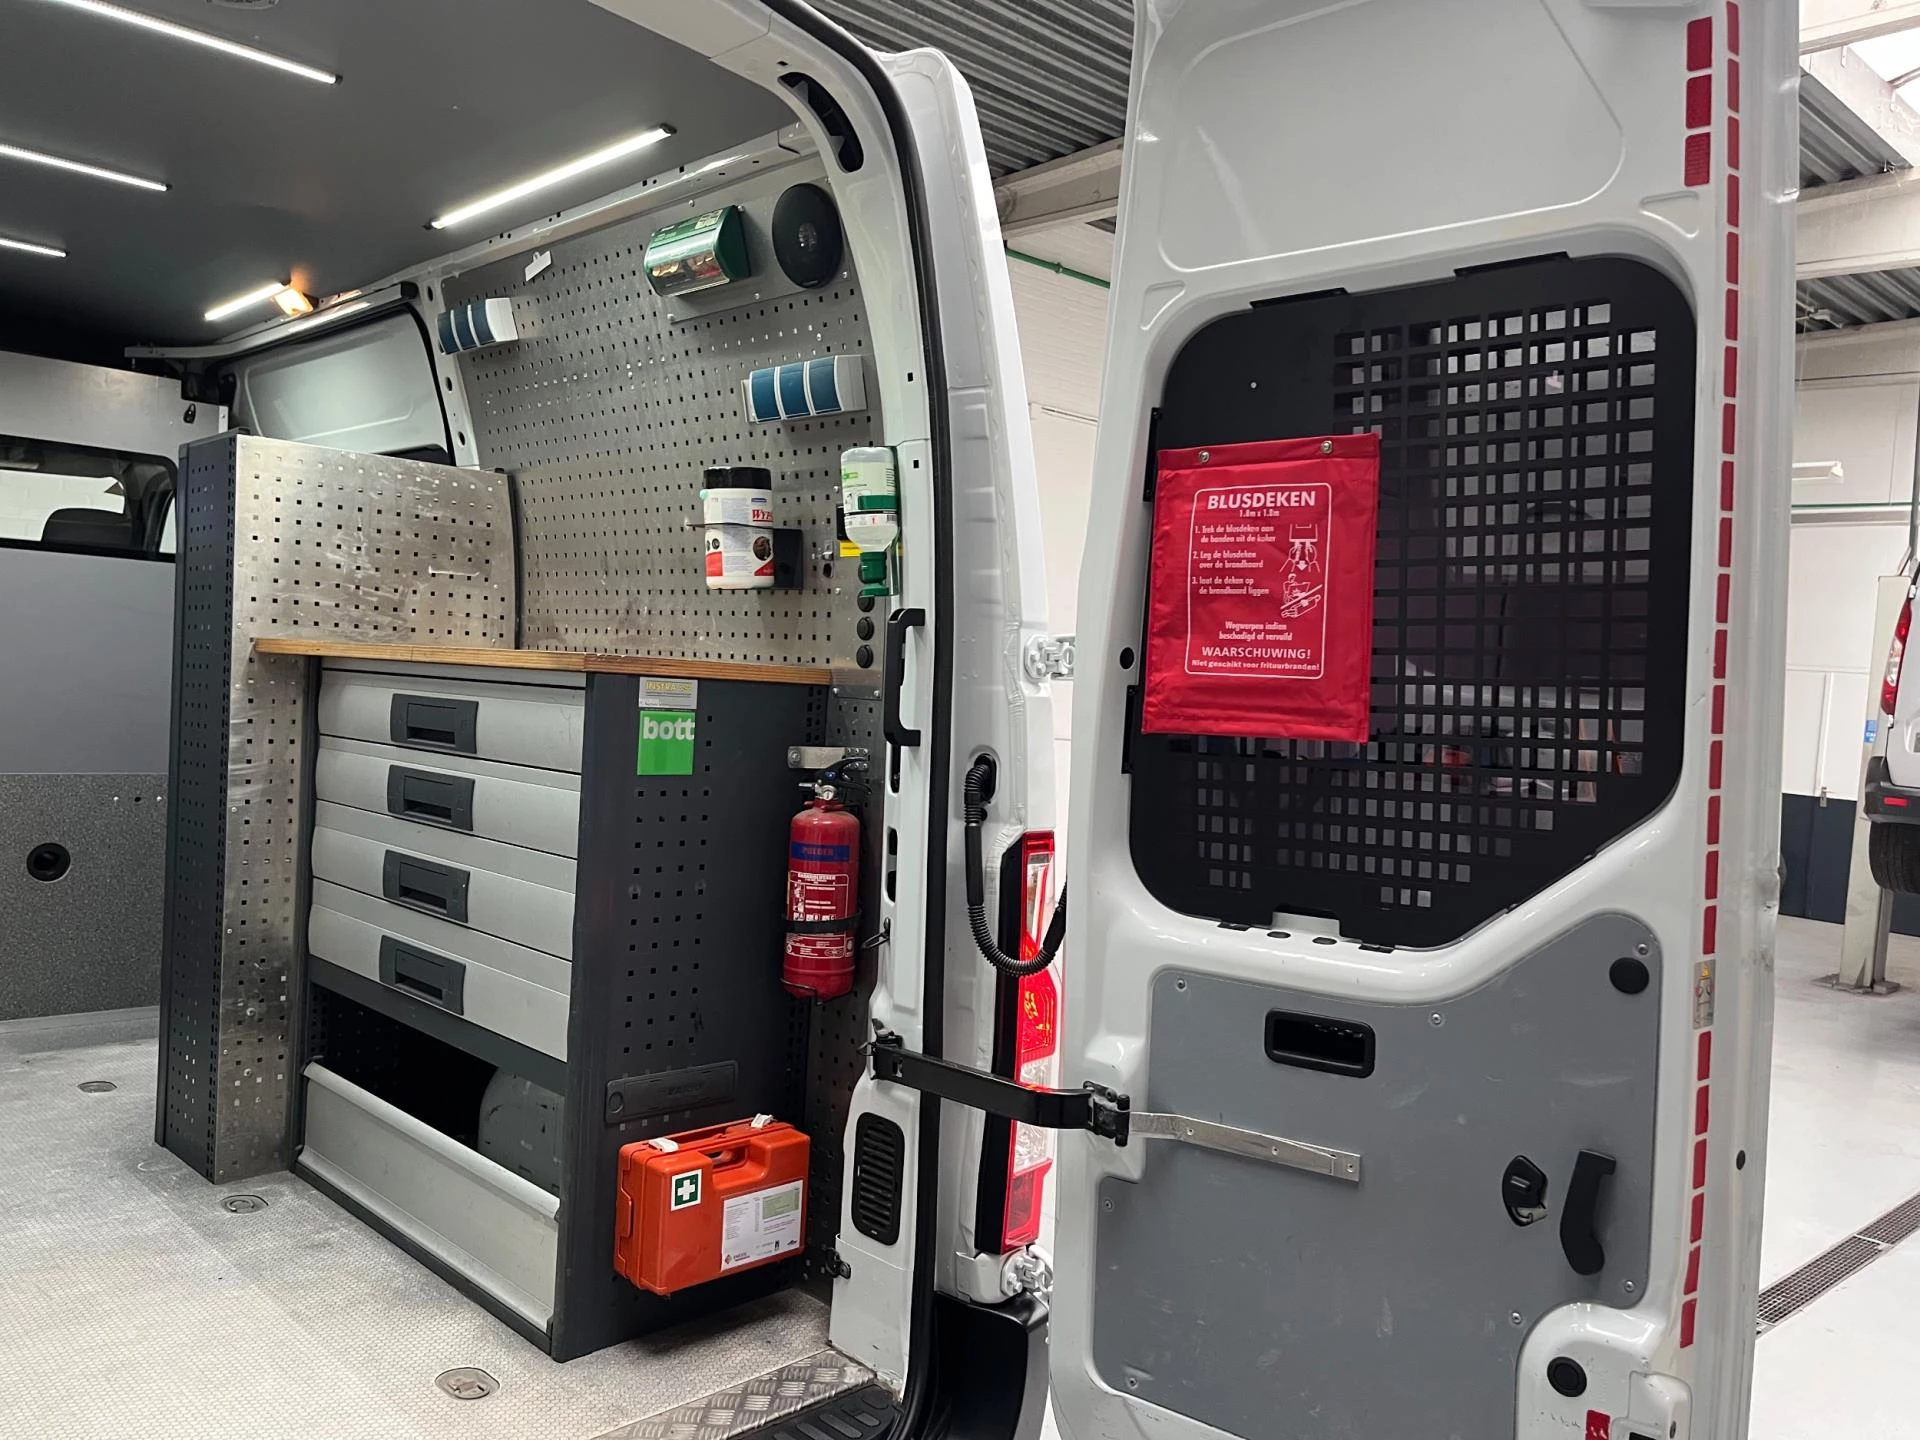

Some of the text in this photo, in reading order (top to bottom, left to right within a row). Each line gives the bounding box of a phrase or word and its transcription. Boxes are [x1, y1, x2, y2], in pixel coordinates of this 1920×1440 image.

[1207, 491, 1316, 510] BLUSDEKEN
[1194, 526, 1200, 534] 1.
[1216, 525, 1224, 533] de
[1226, 524, 1259, 533] blusdeken
[1210, 535, 1235, 543] banden
[1246, 534, 1256, 542] de
[1192, 550, 1257, 560] 2. Leg de blusdeken
[1214, 560, 1223, 568] de
[1225, 560, 1264, 568] brandhaard
[1214, 576, 1223, 584] de
[1224, 576, 1244, 584] deken
[1245, 578, 1254, 586] op
[1199, 586, 1269, 596] de brandhaard liggen
[1225, 621, 1264, 631] Wegwerpen
[1219, 631, 1293, 642] beschadigd of vervuild
[1201, 646, 1311, 659] WAARSCHUWING!
[1208, 660, 1242, 668] geschikt
[1260, 661, 1320, 671] frituurbranden!
[643, 716, 696, 741] bott
